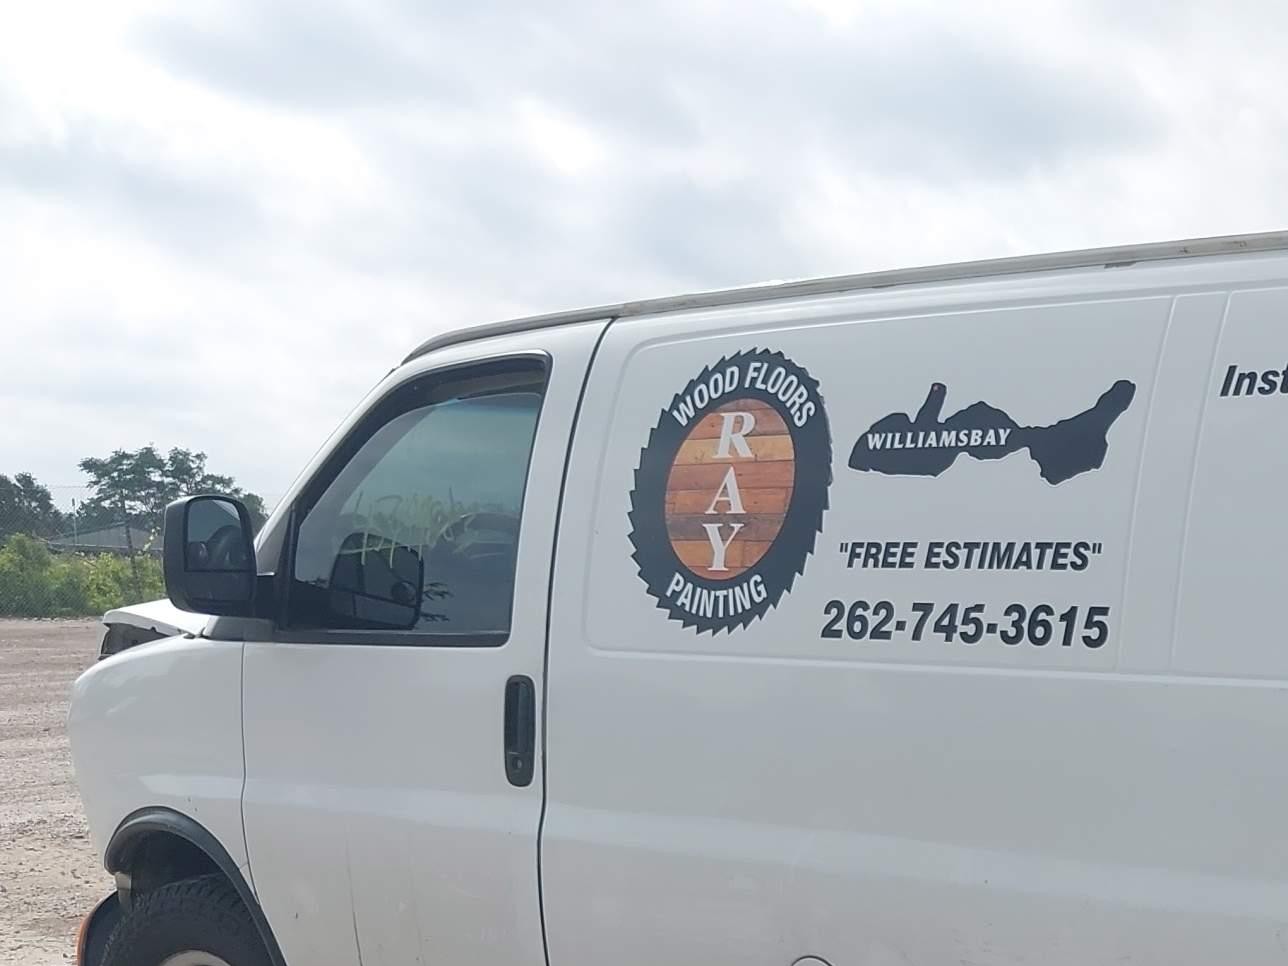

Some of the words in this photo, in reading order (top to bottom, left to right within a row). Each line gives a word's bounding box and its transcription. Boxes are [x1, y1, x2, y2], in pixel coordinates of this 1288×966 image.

[672, 364, 741, 429] WOOD
[744, 361, 816, 427] FLOORS
[866, 427, 1012, 451] WILLIAMSBAY
[704, 410, 756, 572] RAY
[839, 541, 915, 570] "FREE
[924, 541, 1102, 571] ESTIMATES"
[664, 572, 768, 619] PAINTING
[820, 600, 1110, 648] 262-745-3615
